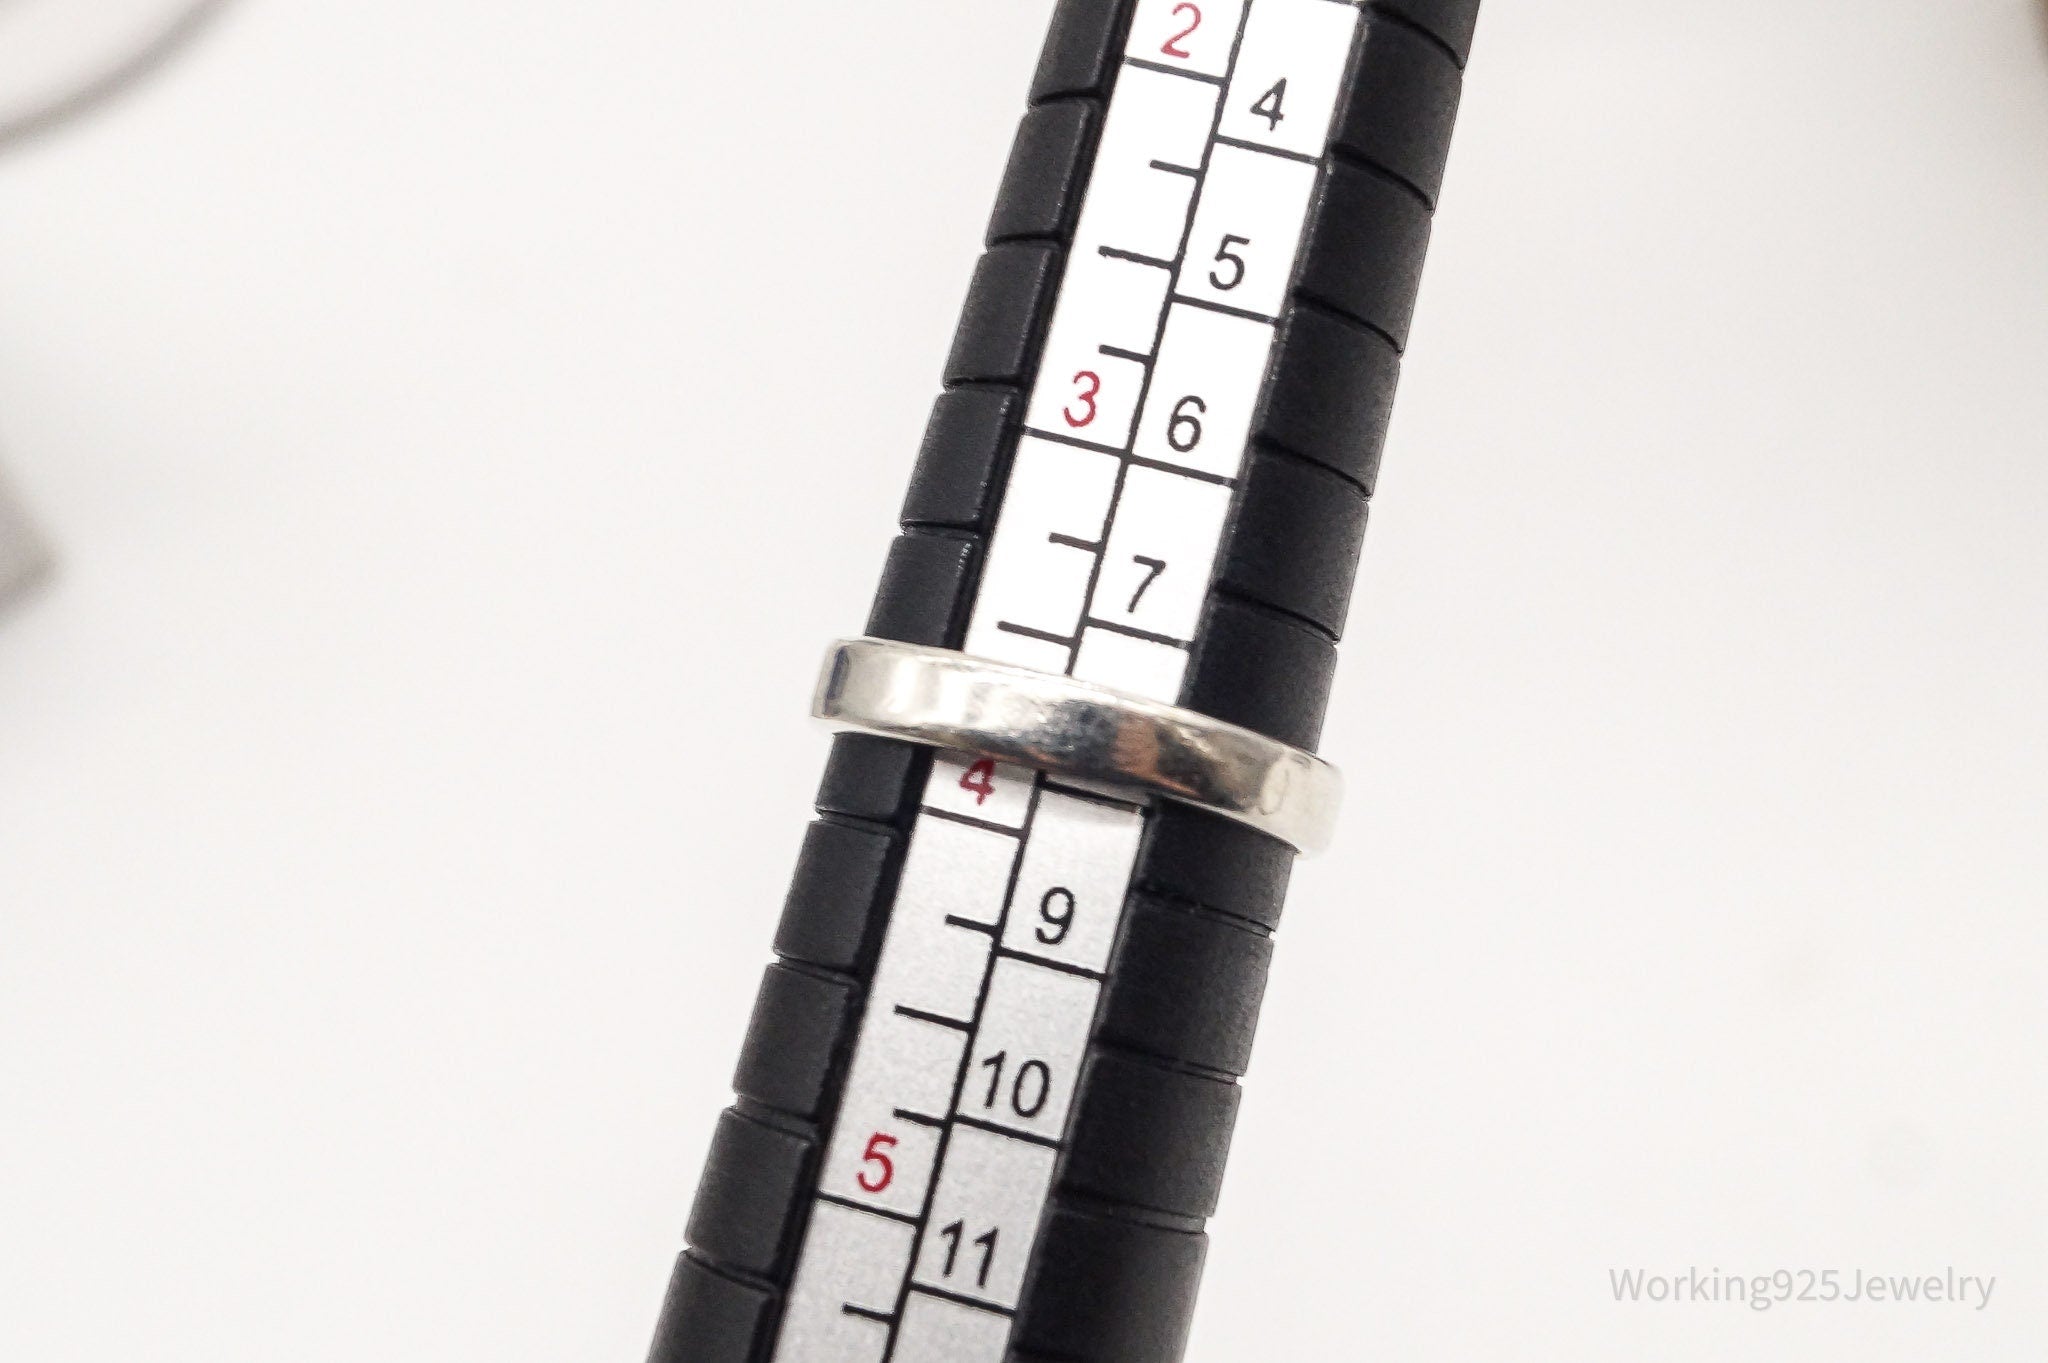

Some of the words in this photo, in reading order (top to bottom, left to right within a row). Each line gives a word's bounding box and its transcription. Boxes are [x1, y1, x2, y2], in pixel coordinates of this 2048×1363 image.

[1161, 2, 1200, 59] 2
[1251, 77, 1288, 131] 4
[1209, 233, 1250, 291] 5
[1063, 370, 1100, 428] 3
[1167, 396, 1206, 452] 6
[1128, 554, 1166, 613] 7
[959, 759, 995, 805] 4
[1036, 887, 1075, 945] 9
[982, 1050, 1051, 1118] 10
[857, 1132, 898, 1193] 5
[940, 1220, 999, 1287] 11
